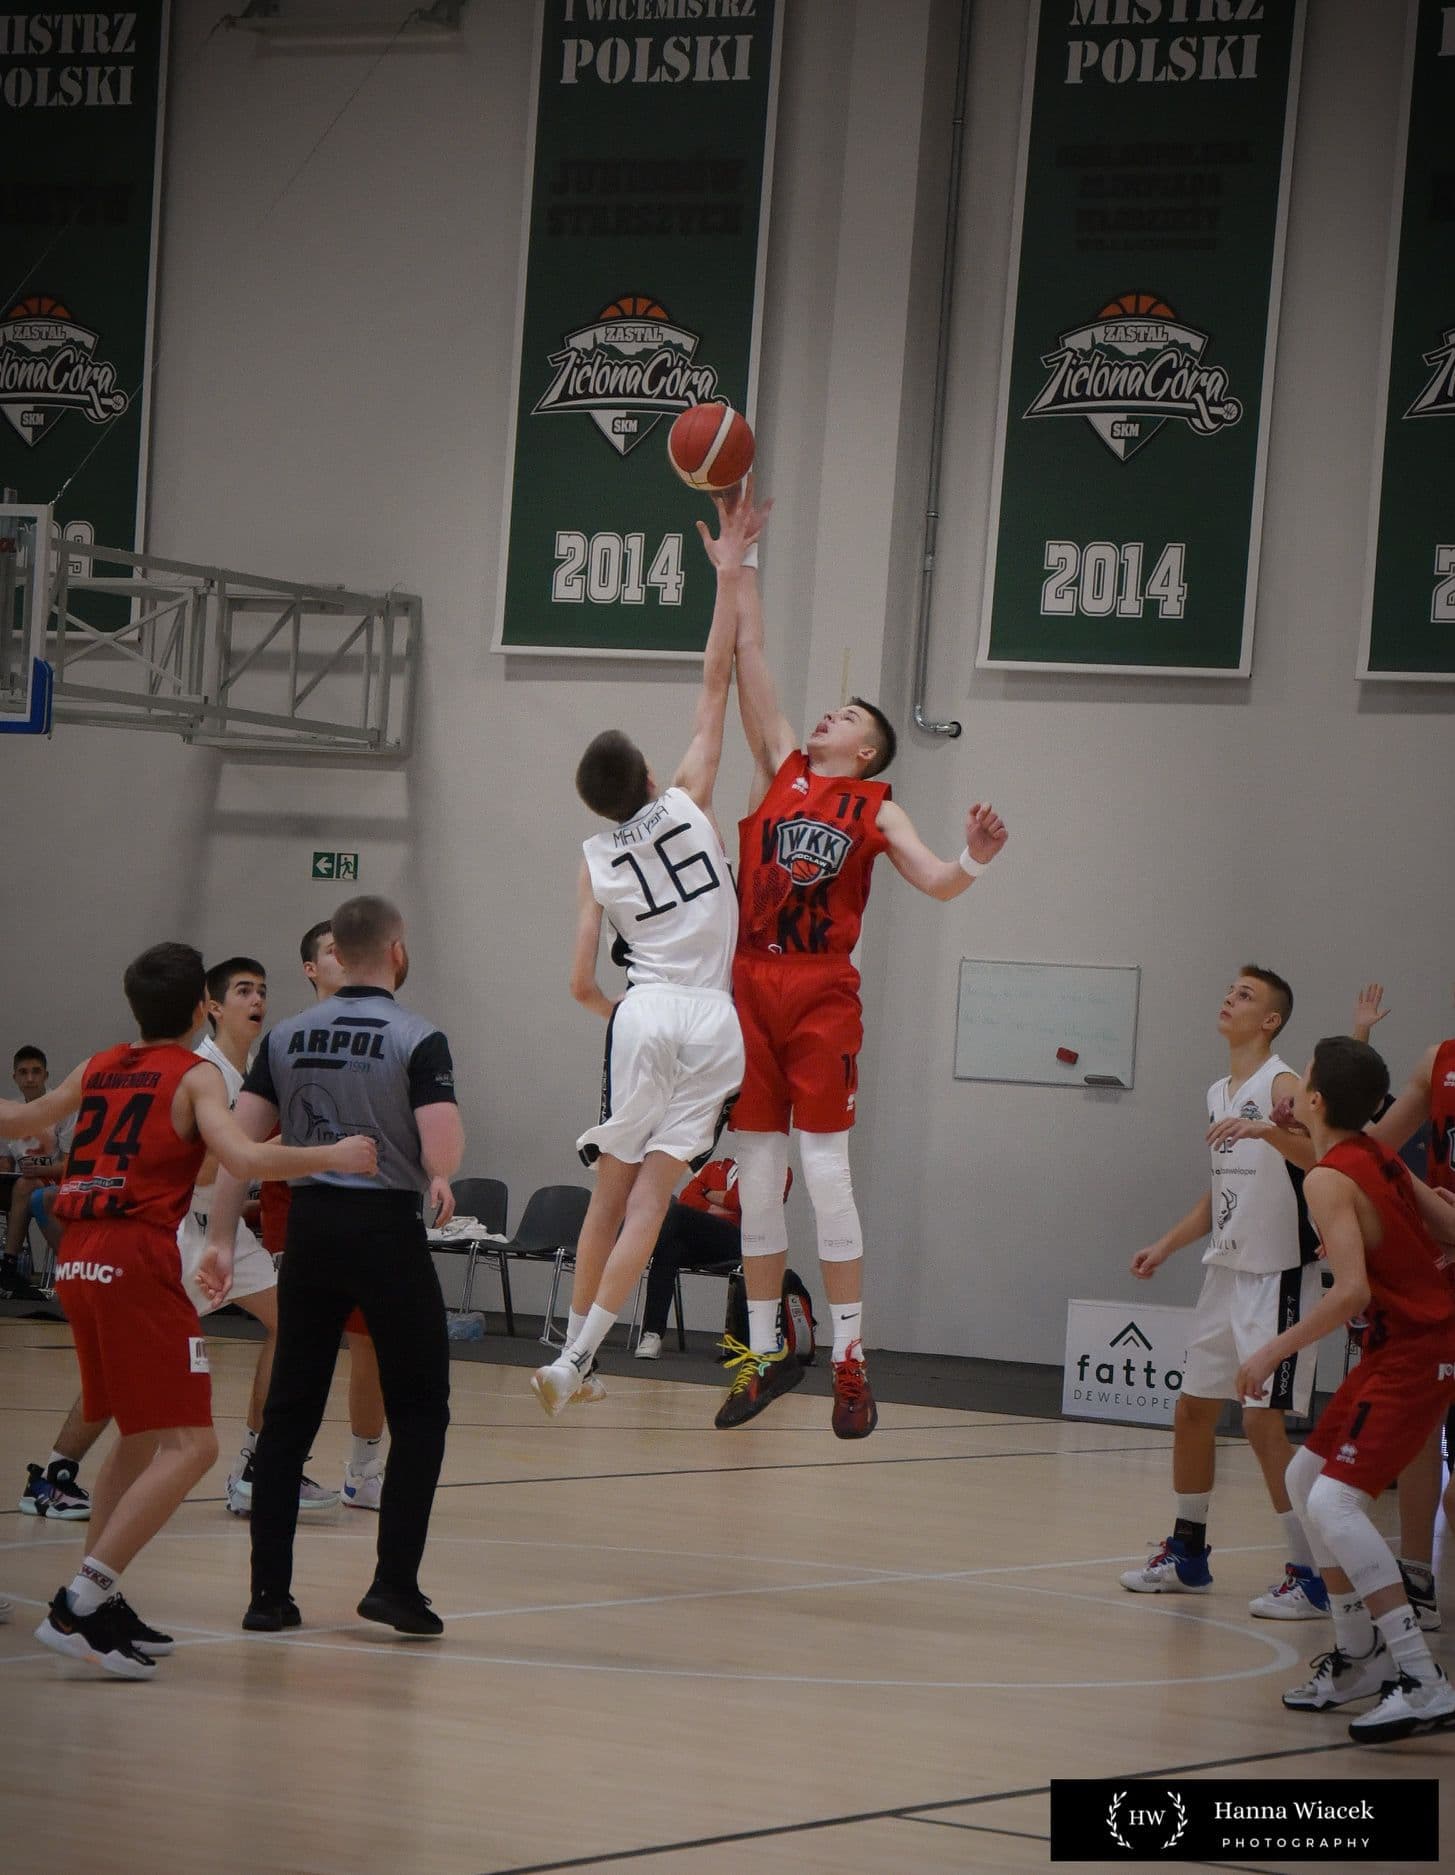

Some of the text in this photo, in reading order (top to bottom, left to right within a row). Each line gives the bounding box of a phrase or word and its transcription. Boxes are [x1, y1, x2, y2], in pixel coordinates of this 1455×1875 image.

[560, 34, 754, 84] POLSKI
[1064, 34, 1261, 84] POLSKI
[0, 66, 134, 108] OLSKI
[14, 325, 66, 340] ZASTAL
[605, 326, 663, 342] ZASTAL
[1104, 325, 1168, 341] ZASTAL
[541, 348, 716, 407] Zielona Góra
[1030, 349, 1225, 411] Zielona Góra
[22, 412, 45, 426] SKM
[612, 420, 639, 434] SKM
[1111, 423, 1140, 438] SKM
[552, 531, 685, 606] 2014
[1040, 541, 1188, 619] 2014
[836, 792, 868, 820] 11
[788, 825, 841, 864] WKK
[611, 822, 720, 922] 16
[287, 1029, 385, 1060] ARPOL
[67, 1093, 155, 1178] 24
[1077, 1354, 1183, 1391] fatto
